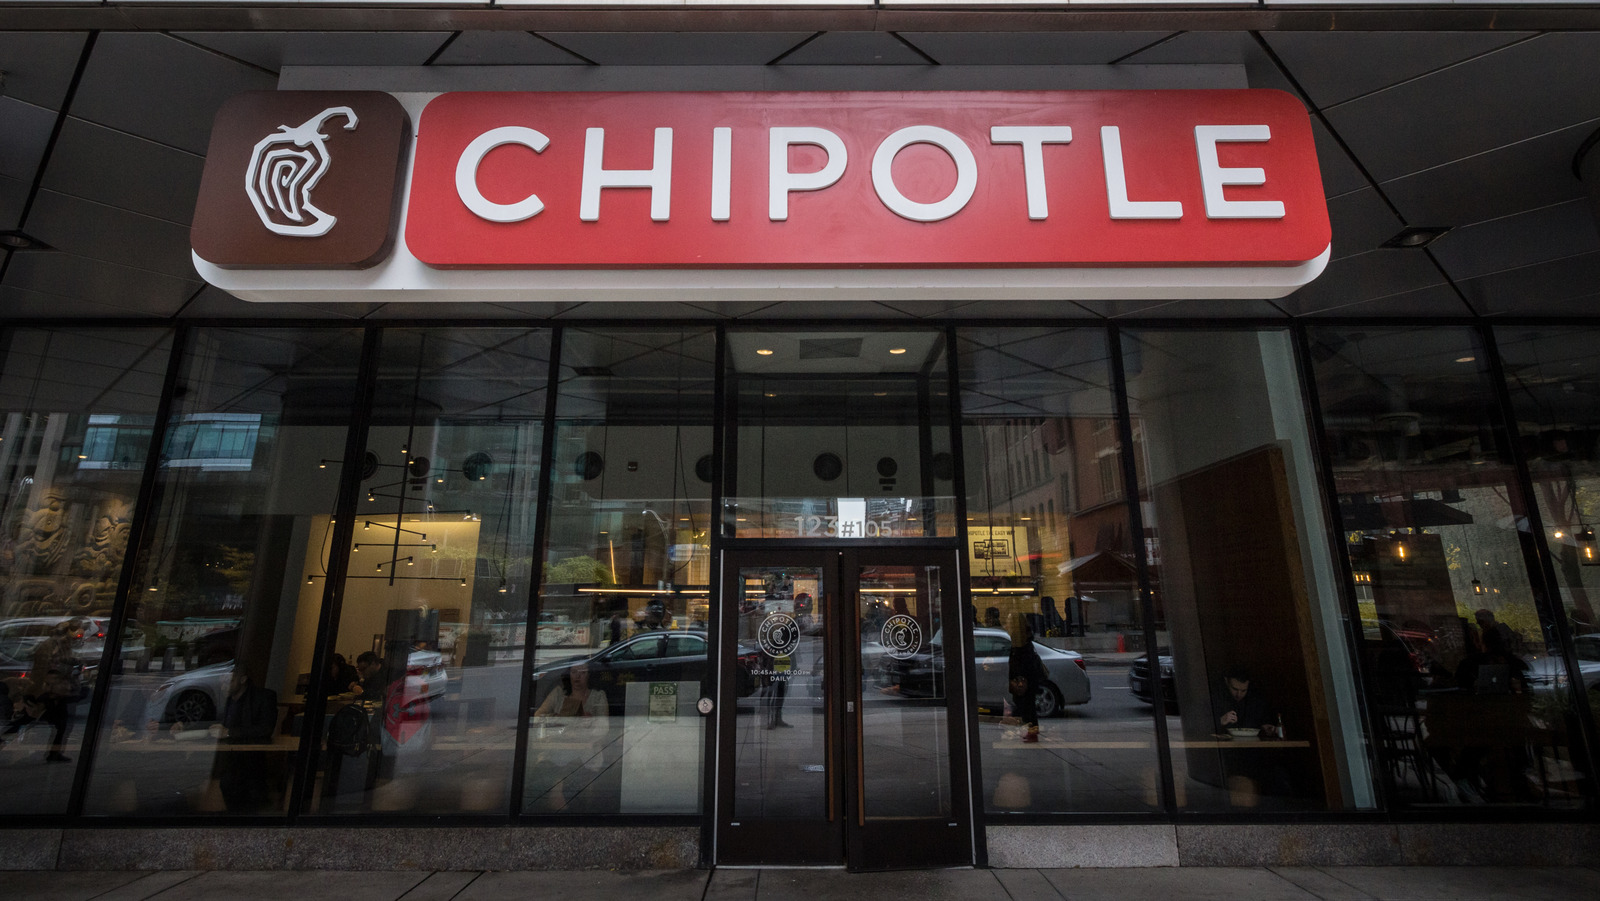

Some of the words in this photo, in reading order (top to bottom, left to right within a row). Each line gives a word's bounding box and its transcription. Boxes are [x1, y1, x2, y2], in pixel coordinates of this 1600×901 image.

[455, 125, 1286, 222] CHIPOTLE
[794, 516, 838, 537] 123
[841, 520, 892, 537] #105
[762, 616, 797, 633] CHIPOTLE
[884, 617, 918, 634] CHIPOTLE
[653, 686, 674, 695] PASS
